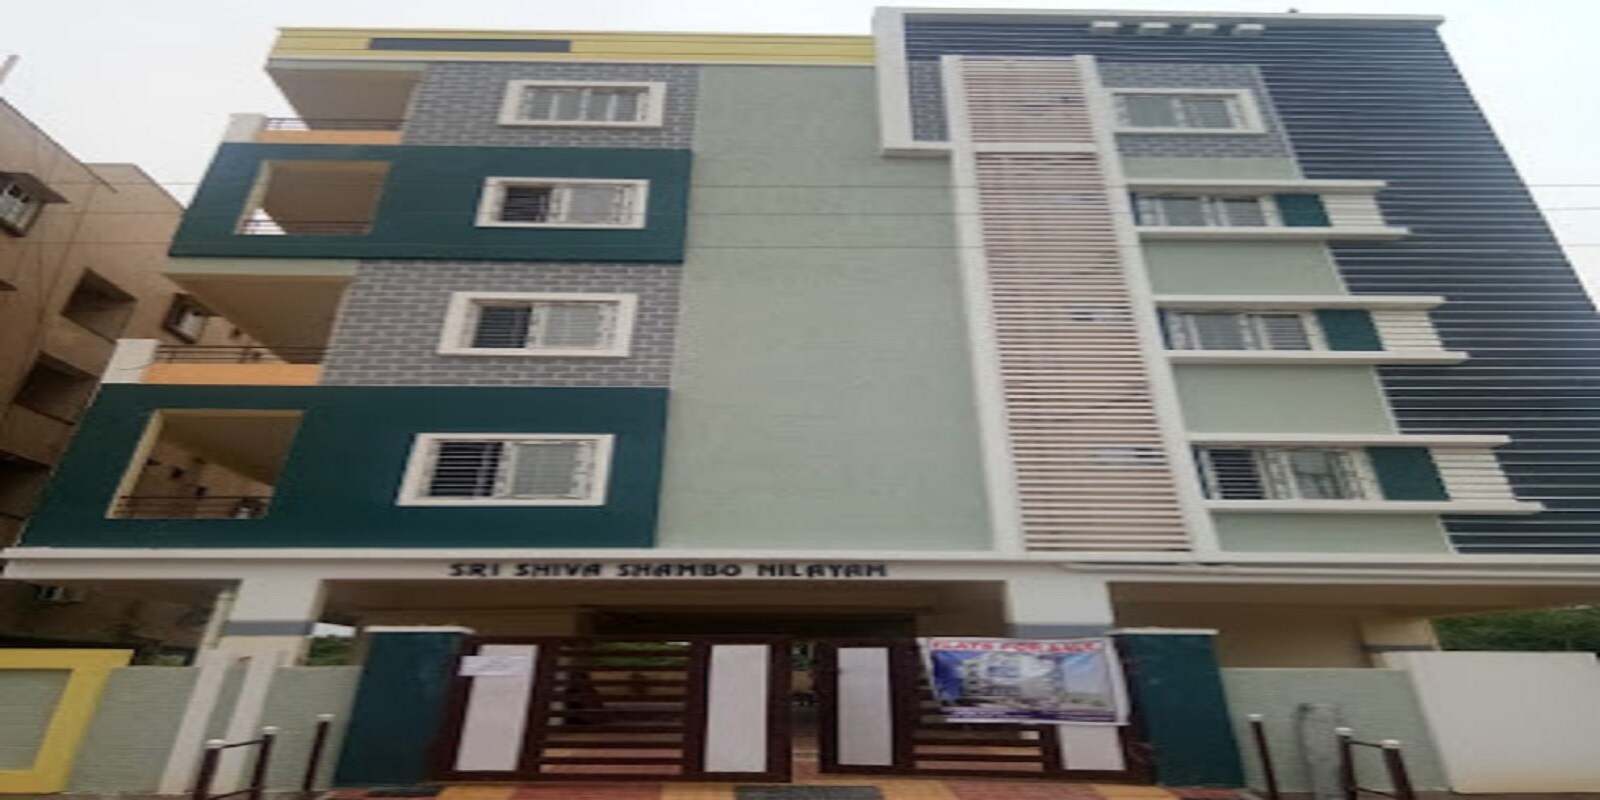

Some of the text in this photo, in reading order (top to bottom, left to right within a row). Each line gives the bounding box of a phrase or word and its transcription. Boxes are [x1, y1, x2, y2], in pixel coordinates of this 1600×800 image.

[449, 563, 888, 577] SRI SHIVA SHAMBO NILAYAM
